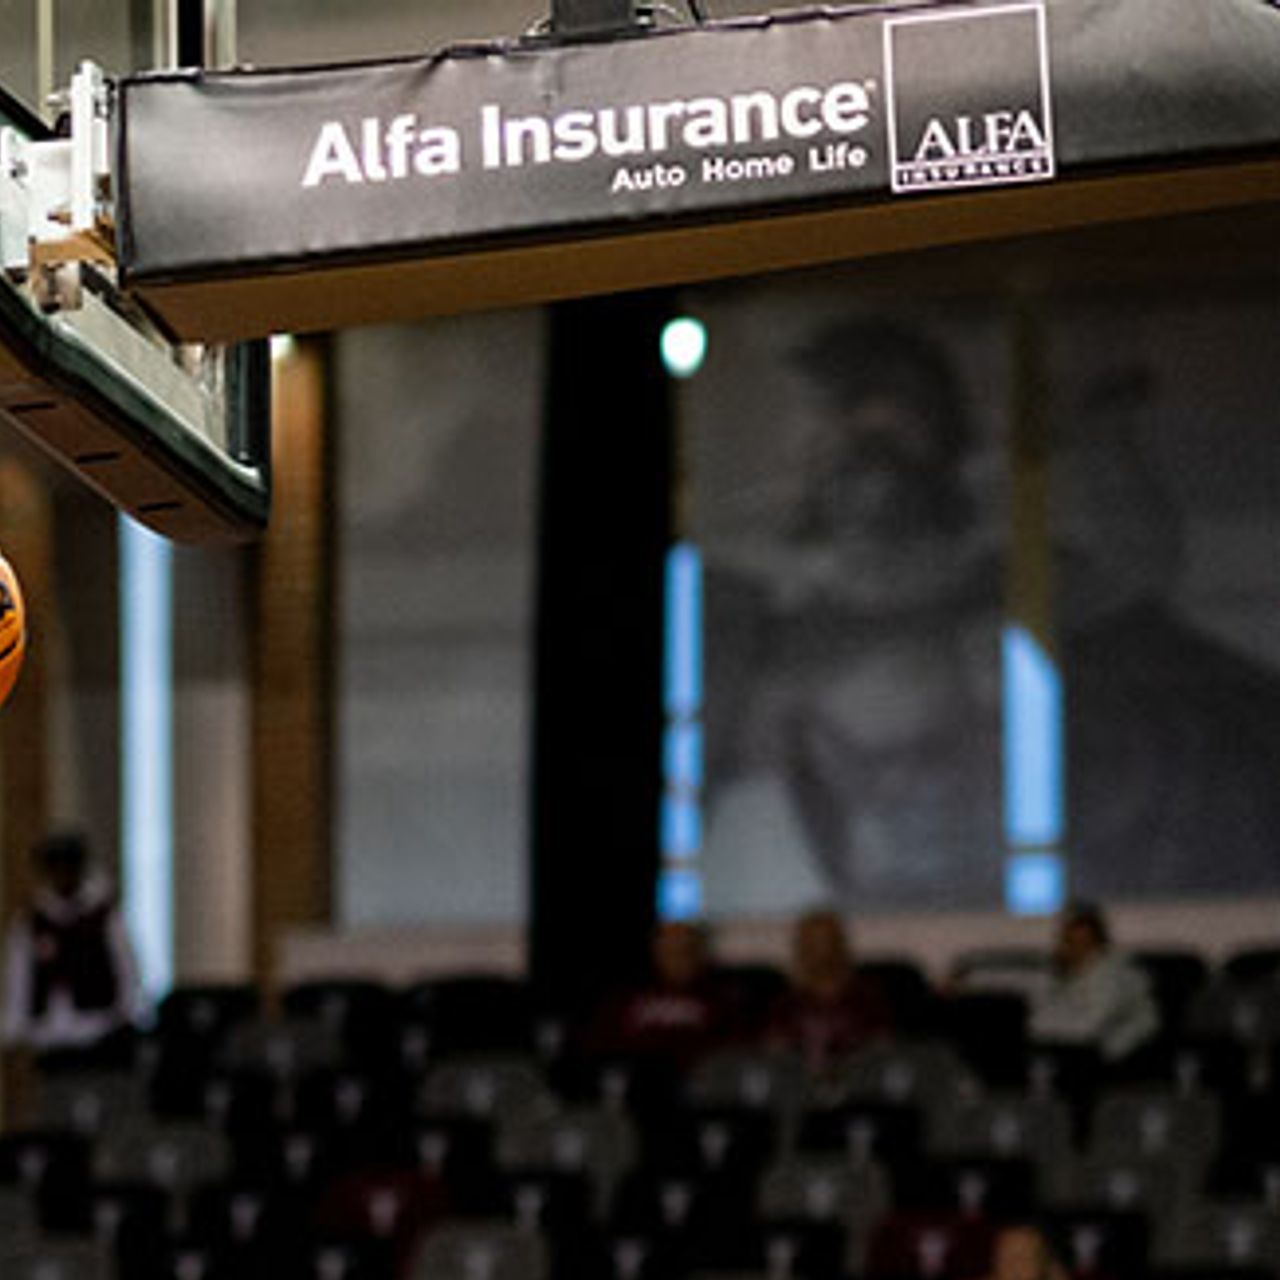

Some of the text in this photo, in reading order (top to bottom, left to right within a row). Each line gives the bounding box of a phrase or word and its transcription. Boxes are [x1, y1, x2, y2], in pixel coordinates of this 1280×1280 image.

[301, 80, 871, 187] Alfa Insurance
[915, 110, 1048, 160] ALFA
[611, 141, 868, 193] Auto Home Life
[900, 158, 1044, 185] INSURANCE
